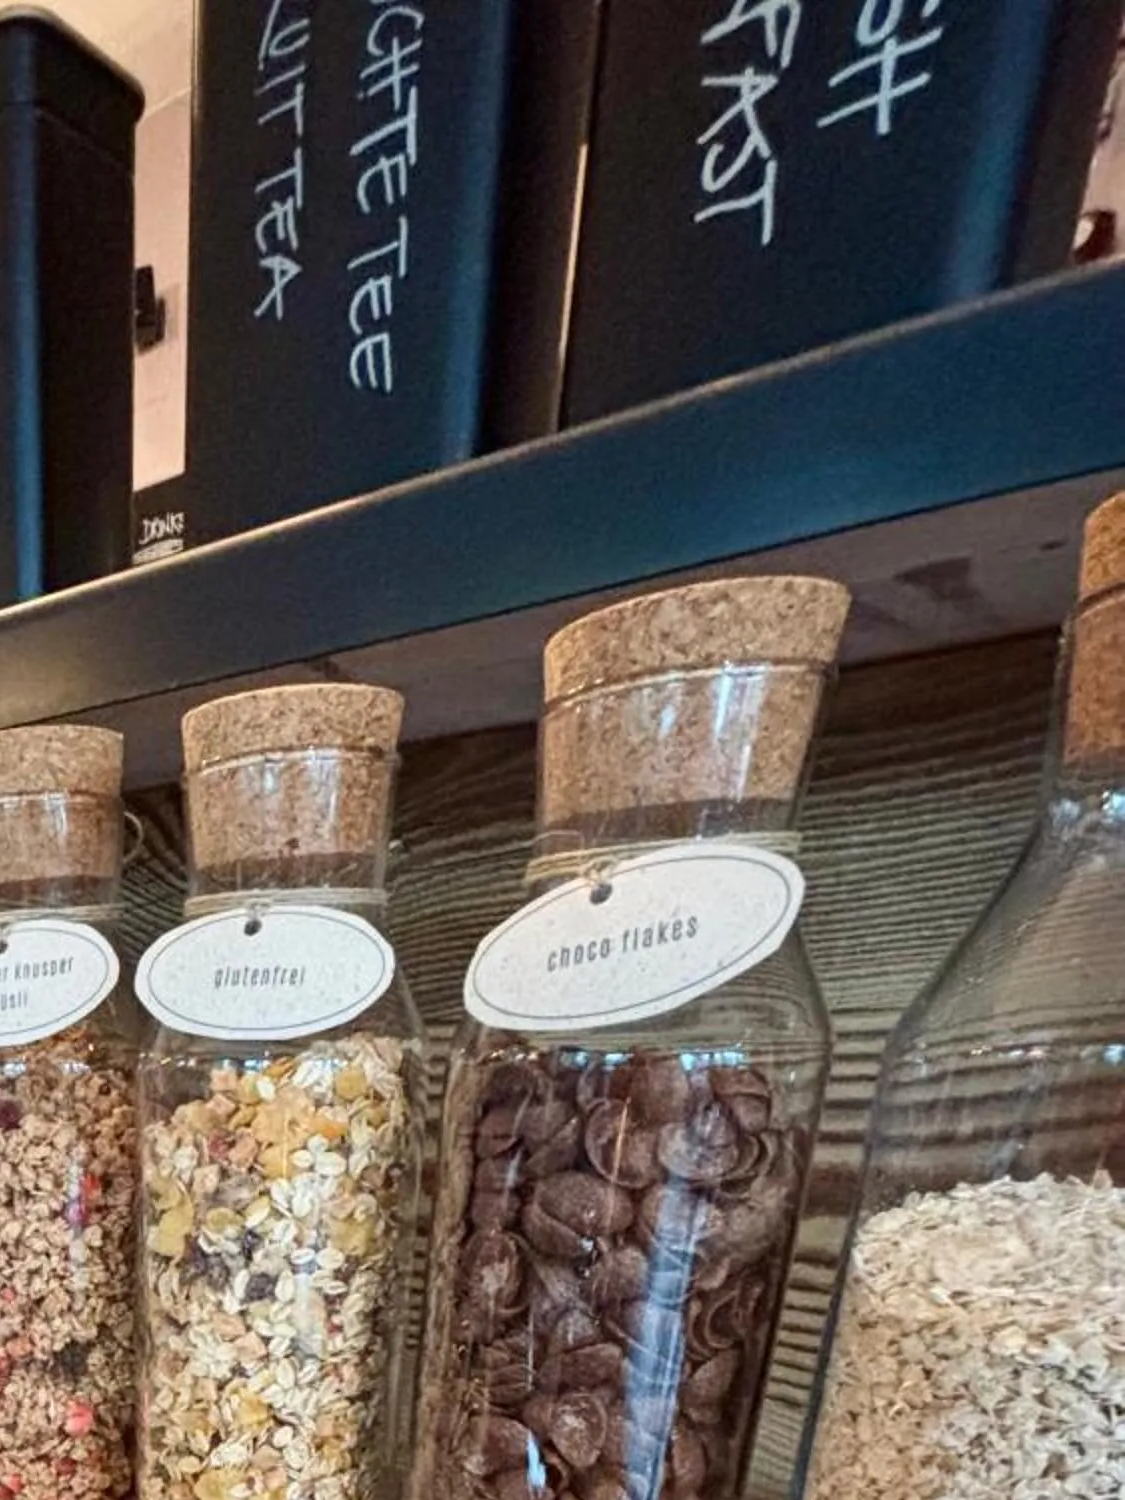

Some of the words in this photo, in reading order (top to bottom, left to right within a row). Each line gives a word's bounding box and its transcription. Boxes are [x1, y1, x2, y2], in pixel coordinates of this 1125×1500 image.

[693, 0, 801, 246] FAST
[253, 146, 304, 320] TEA
[214, 965, 306, 990] glutenfrei
[546, 936, 611, 973] choco
[621, 914, 700, 953] flakes
